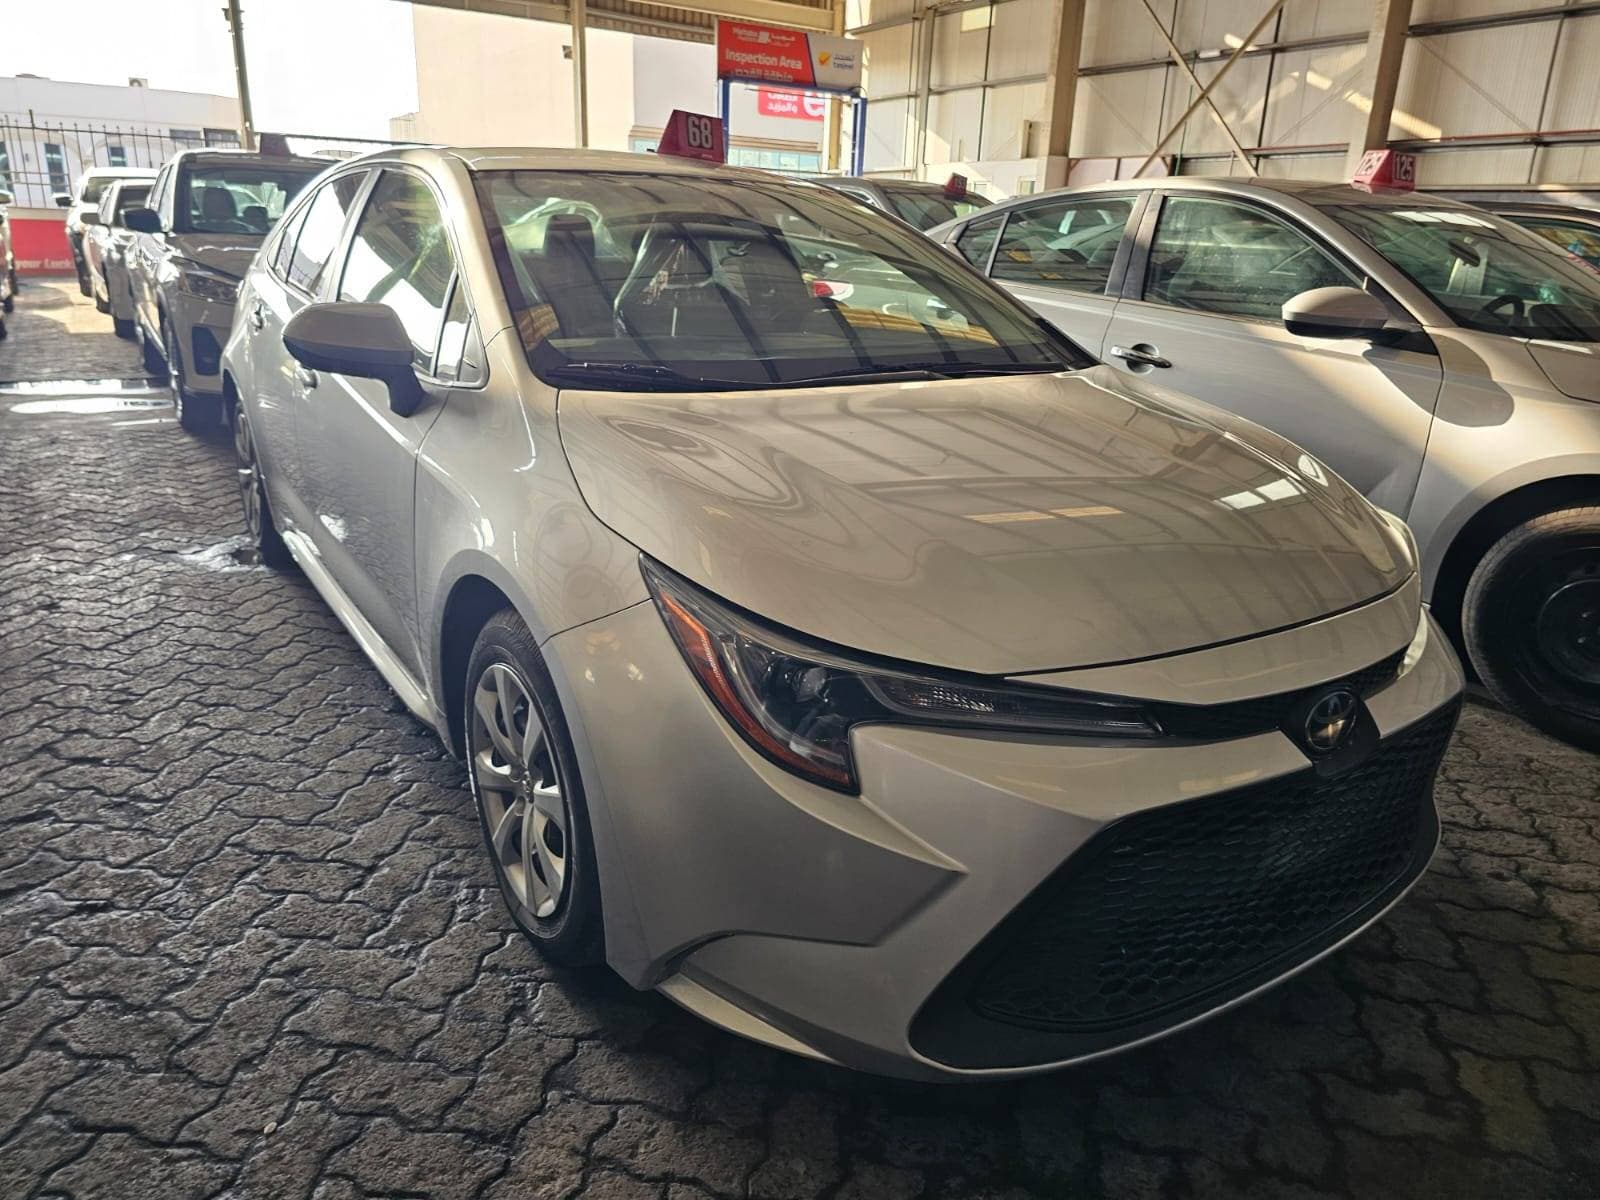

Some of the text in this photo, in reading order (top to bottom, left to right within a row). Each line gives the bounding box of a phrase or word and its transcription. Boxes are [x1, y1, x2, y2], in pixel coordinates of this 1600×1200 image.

[725, 48, 802, 70] Inspection Area
[687, 116, 713, 149] 68
[1395, 154, 1413, 180] 125
